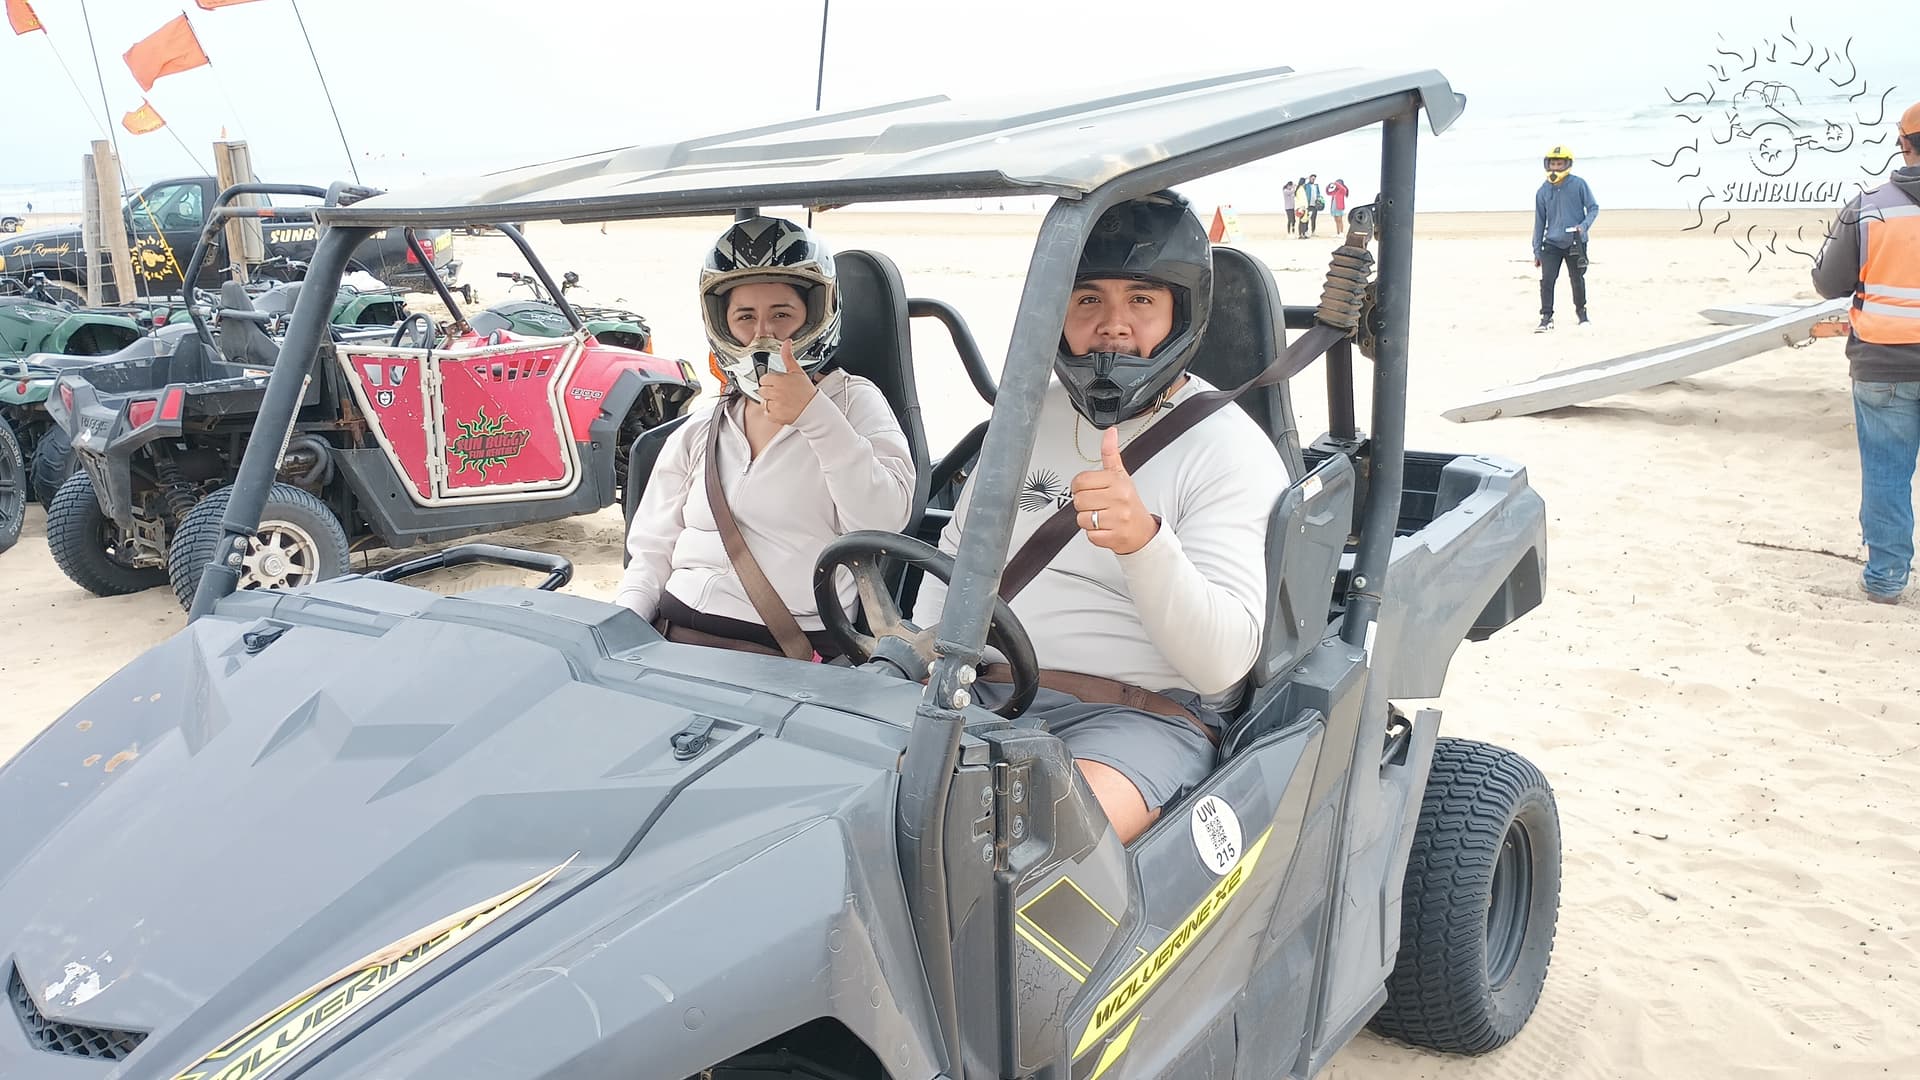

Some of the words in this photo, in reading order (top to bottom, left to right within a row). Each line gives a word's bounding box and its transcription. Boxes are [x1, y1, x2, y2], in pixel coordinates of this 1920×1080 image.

[1196, 798, 1217, 823] UW
[1216, 842, 1236, 868] 215
[1095, 898, 1213, 1030] WOLVERINE
[1212, 866, 1243, 910] X2
